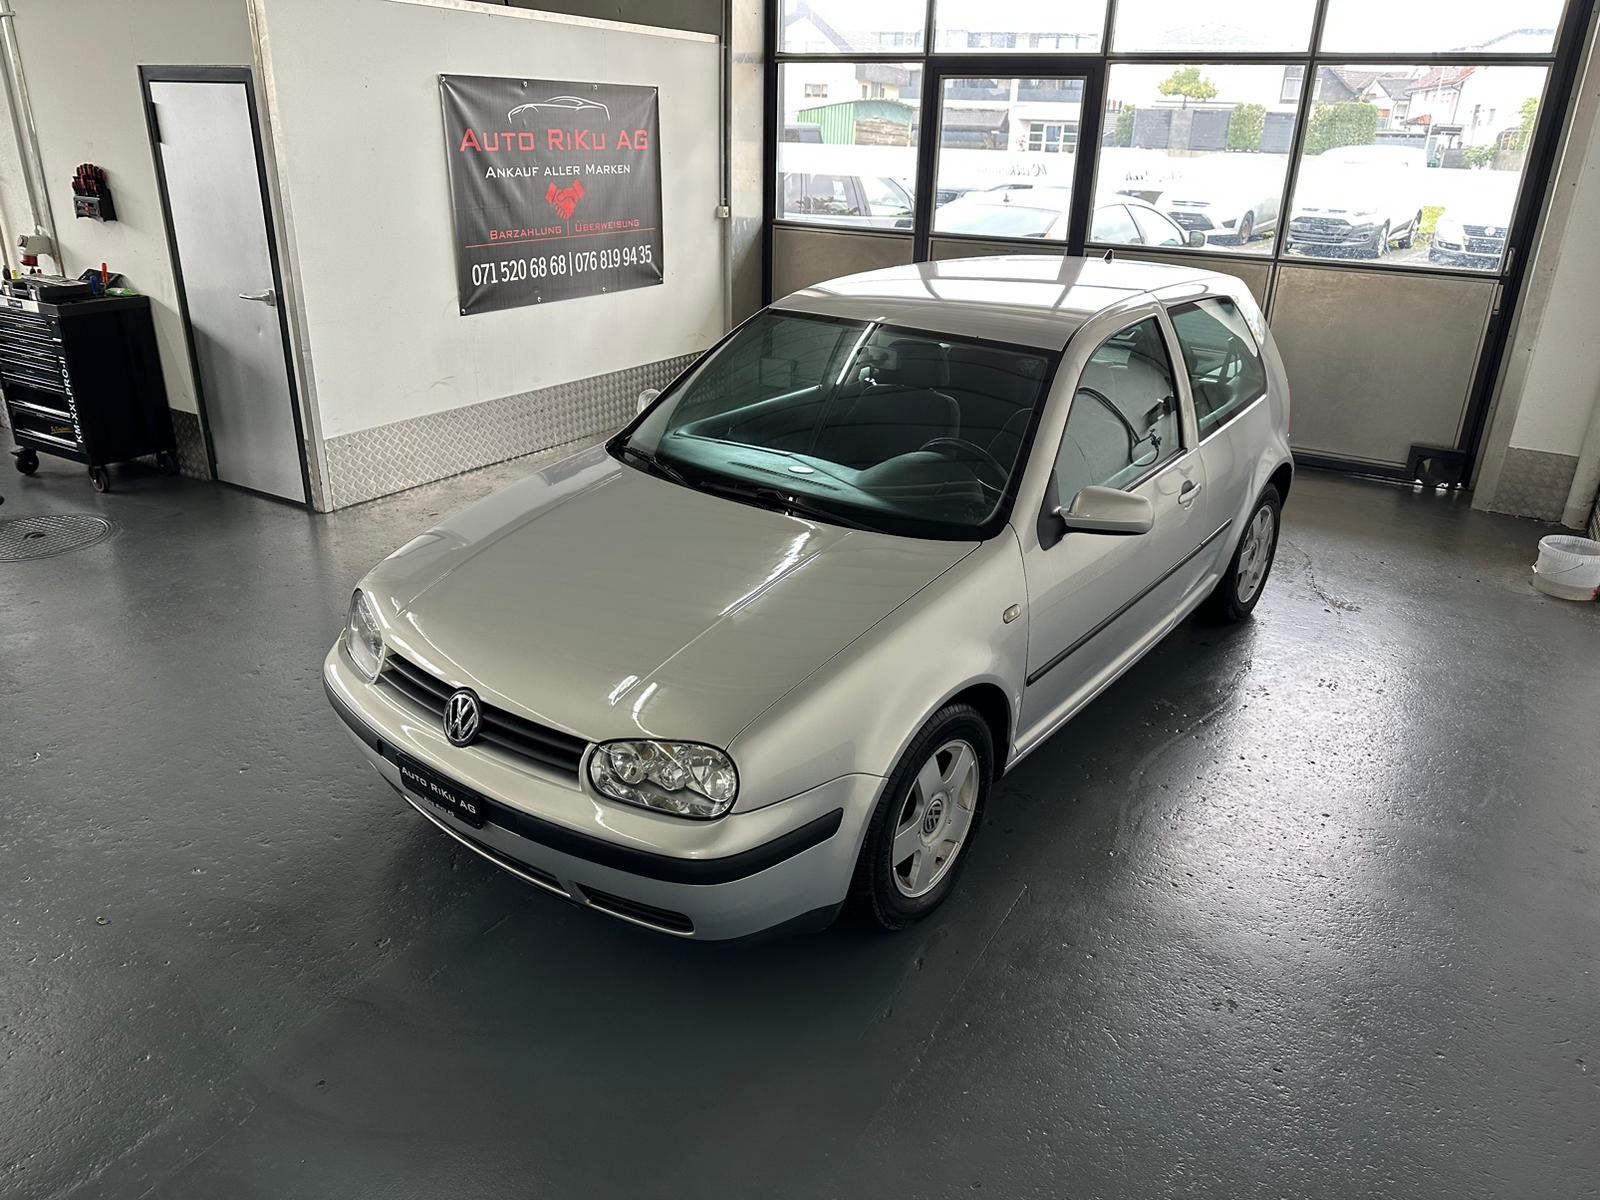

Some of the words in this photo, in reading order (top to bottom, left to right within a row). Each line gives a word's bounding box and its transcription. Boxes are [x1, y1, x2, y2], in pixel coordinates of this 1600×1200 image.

[616, 130, 649, 150] AG
[485, 166, 539, 179] ANKAUF
[543, 165, 581, 177] ALLER
[585, 164, 631, 176] MARKEN
[490, 225, 563, 241] BARZAHLUNG
[471, 263, 499, 287] 071
[500, 259, 527, 283] 520
[529, 256, 548, 279] 68
[549, 252, 567, 276] 68
[575, 250, 598, 273] 076
[600, 248, 621, 270] 819
[623, 246, 638, 267] 94
[638, 244, 652, 265] 35
[459, 799, 477, 815] AG
